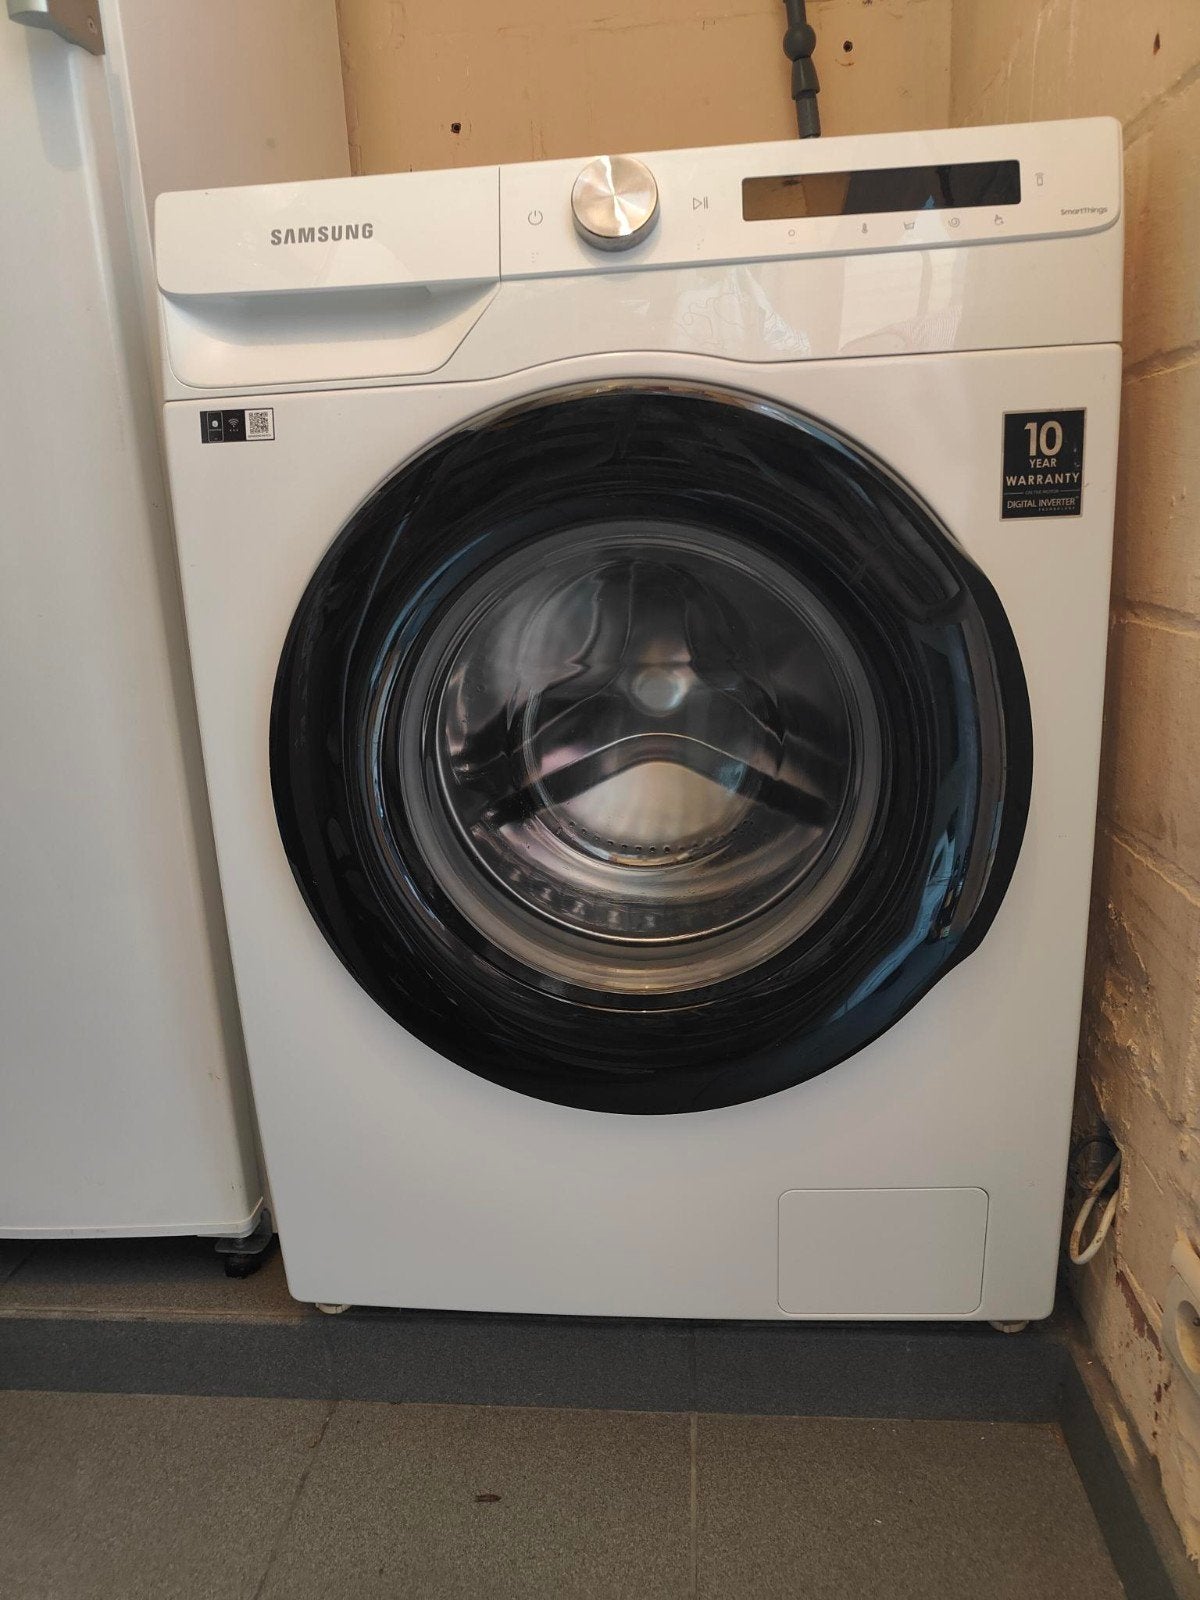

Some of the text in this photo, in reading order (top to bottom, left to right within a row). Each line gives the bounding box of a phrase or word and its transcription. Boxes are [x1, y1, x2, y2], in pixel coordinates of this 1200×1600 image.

[1060, 207, 1108, 216] SmartThings
[270, 223, 374, 246] SAMSUNG
[1024, 420, 1063, 456] 10
[1029, 458, 1057, 469] YEAR
[1006, 472, 1080, 487] WARRANTY
[1007, 500, 1037, 509] DIGITAL
[1038, 498, 1075, 507] INVERTER
